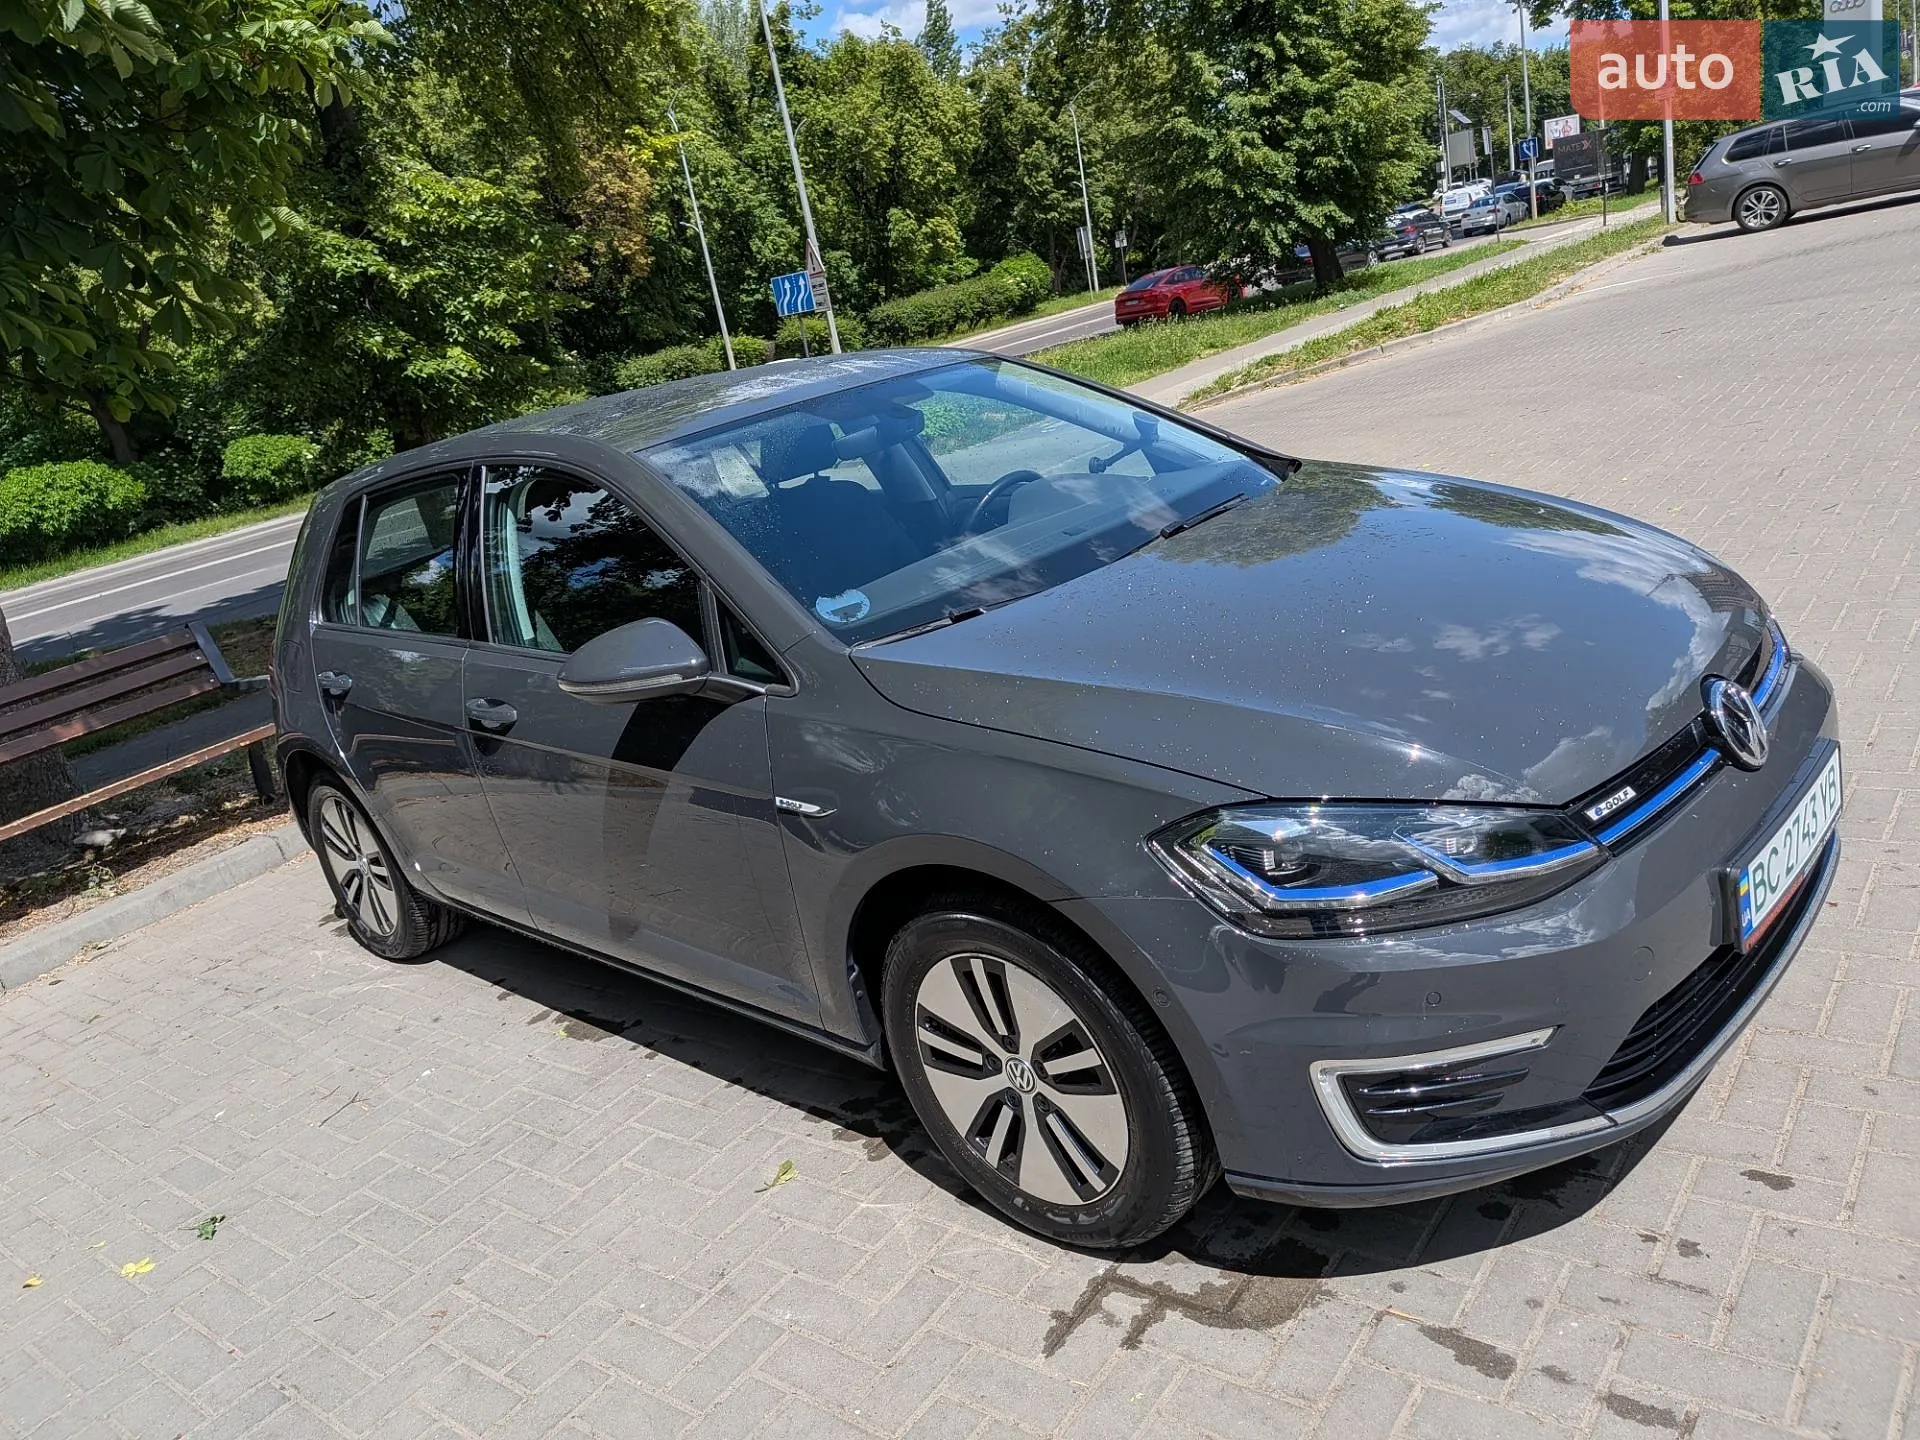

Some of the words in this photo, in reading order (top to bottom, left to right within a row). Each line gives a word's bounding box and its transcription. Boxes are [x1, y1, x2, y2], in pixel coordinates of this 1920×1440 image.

[1752, 847, 1780, 914] BC
[1783, 792, 1818, 877] 2743
[1820, 763, 1837, 820] YB
